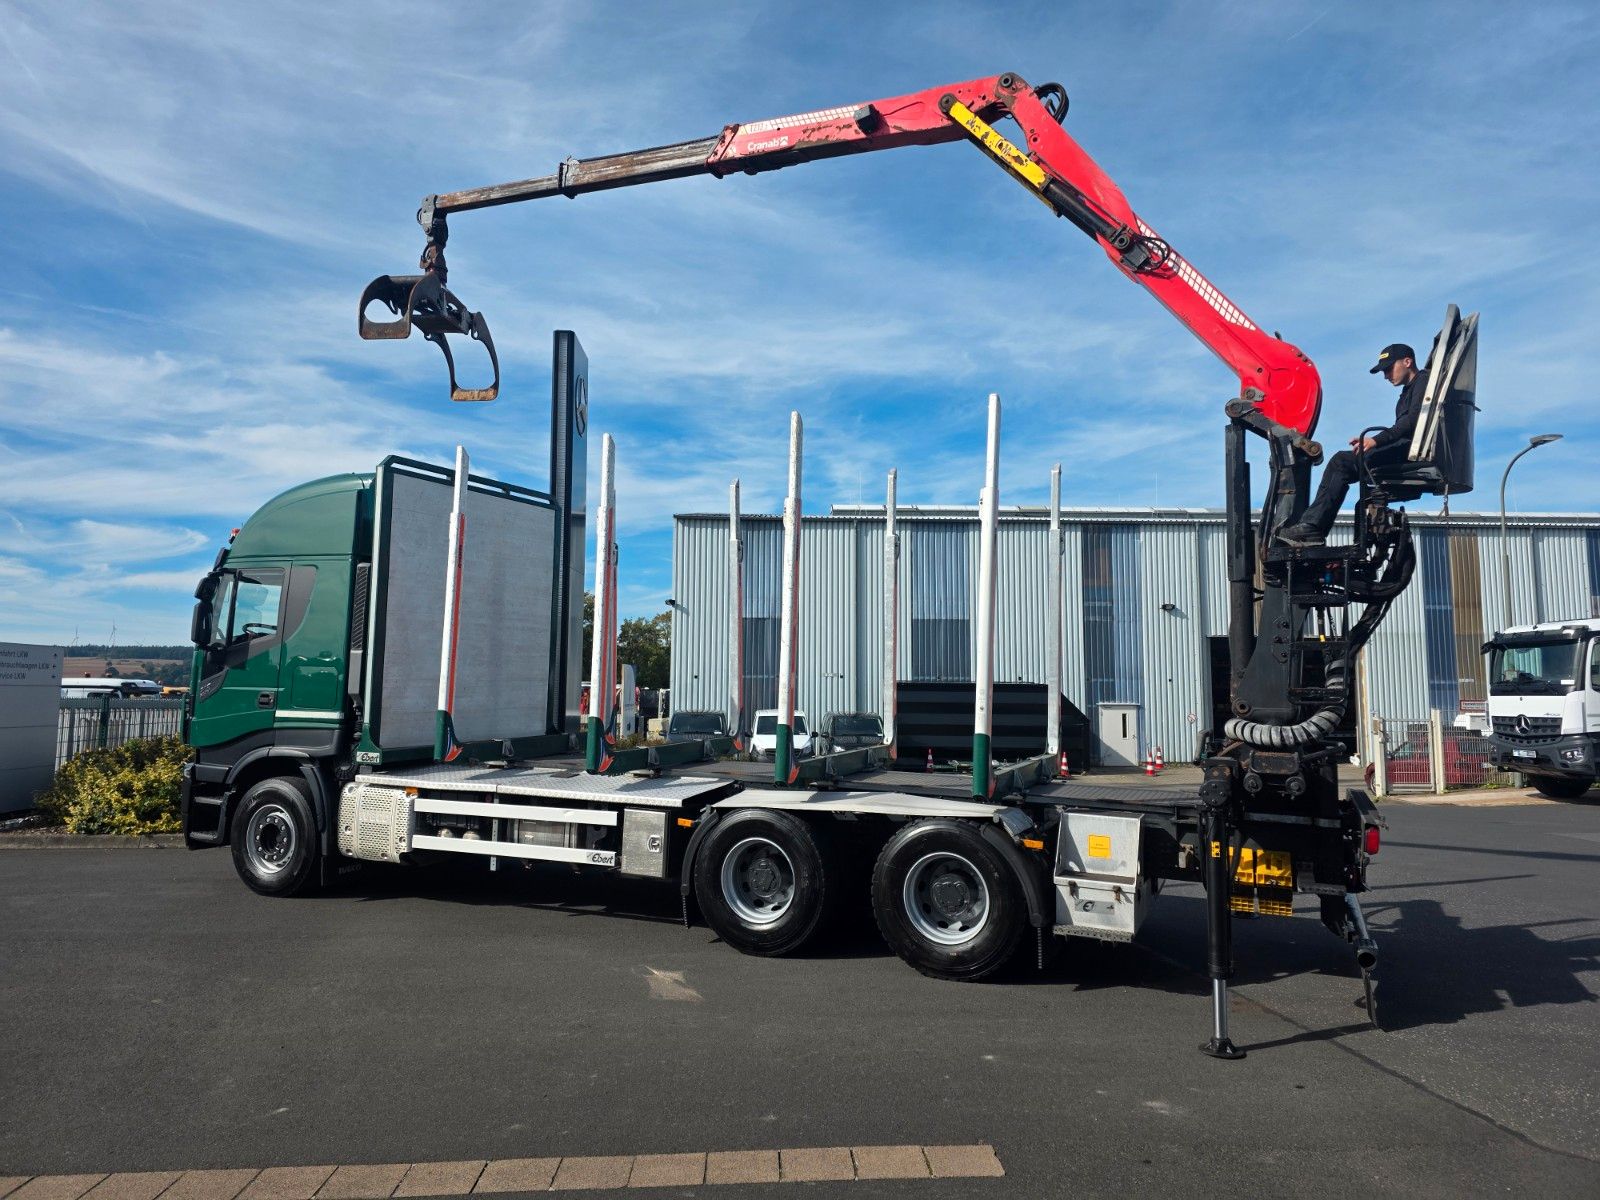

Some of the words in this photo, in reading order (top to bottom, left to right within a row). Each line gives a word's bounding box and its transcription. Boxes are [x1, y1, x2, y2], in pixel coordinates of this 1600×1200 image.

[747, 138, 780, 150] Cranab
[362, 753, 379, 763] Ebert
[592, 853, 613, 864] Ebert
